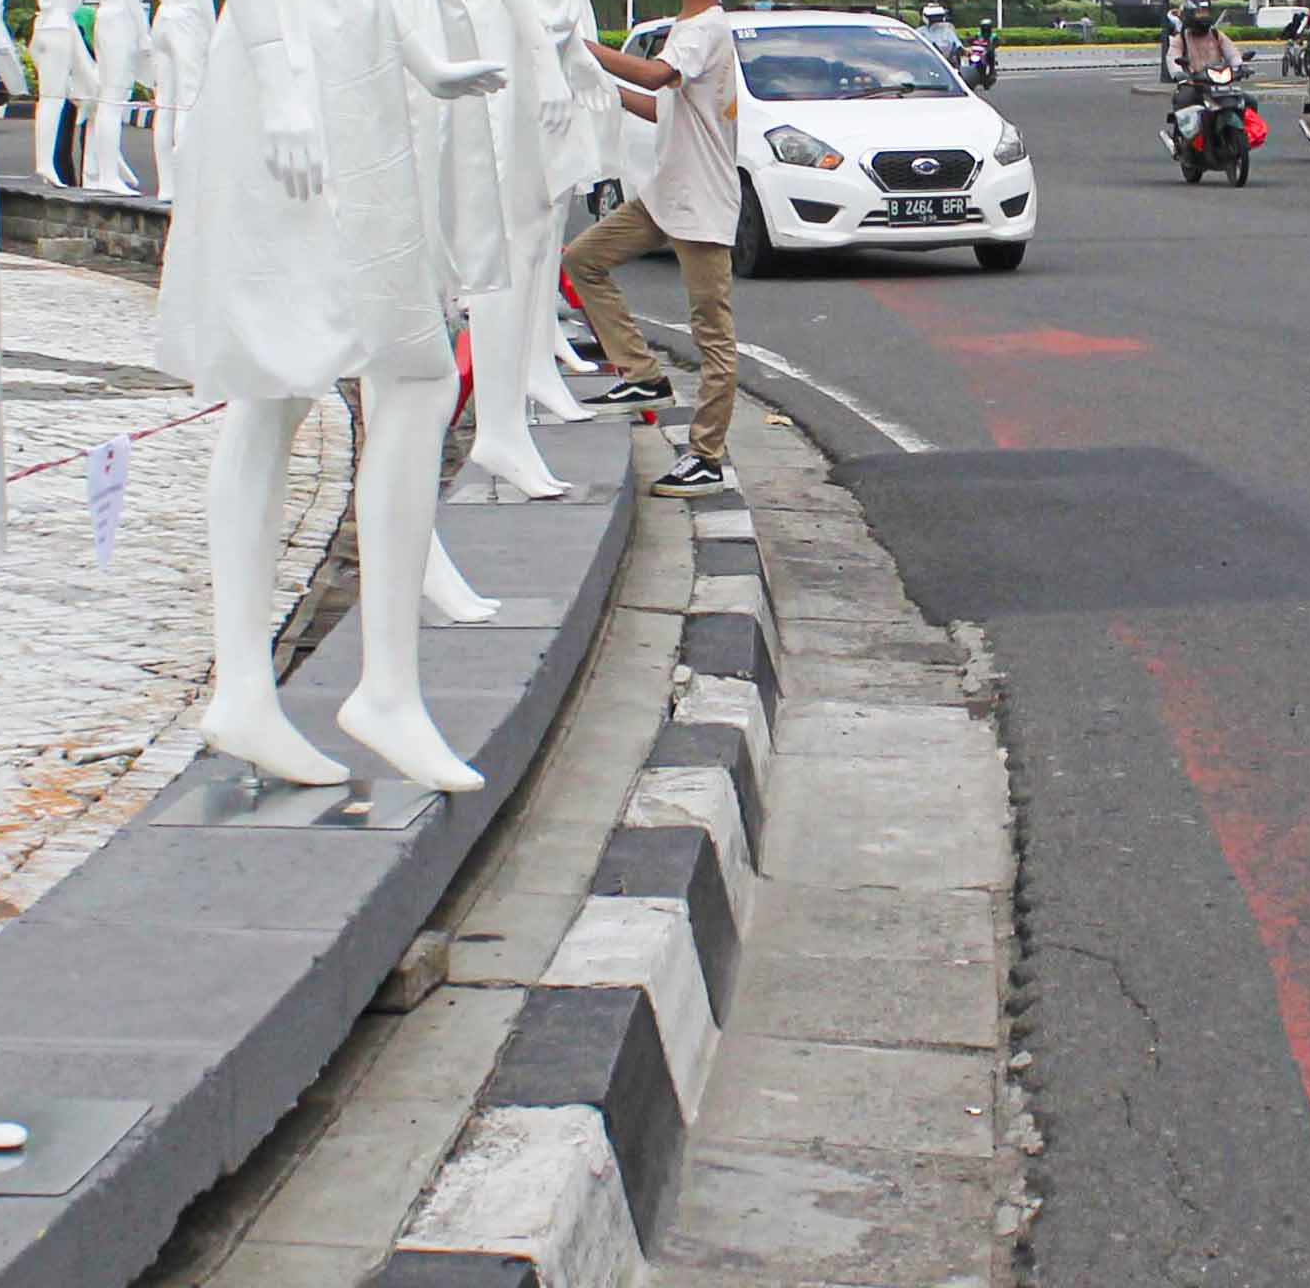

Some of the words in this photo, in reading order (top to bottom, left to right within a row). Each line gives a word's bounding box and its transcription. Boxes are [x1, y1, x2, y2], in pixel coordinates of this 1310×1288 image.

[891, 201, 899, 216] B
[905, 199, 933, 215] 2464
[943, 198, 964, 214] BFR
